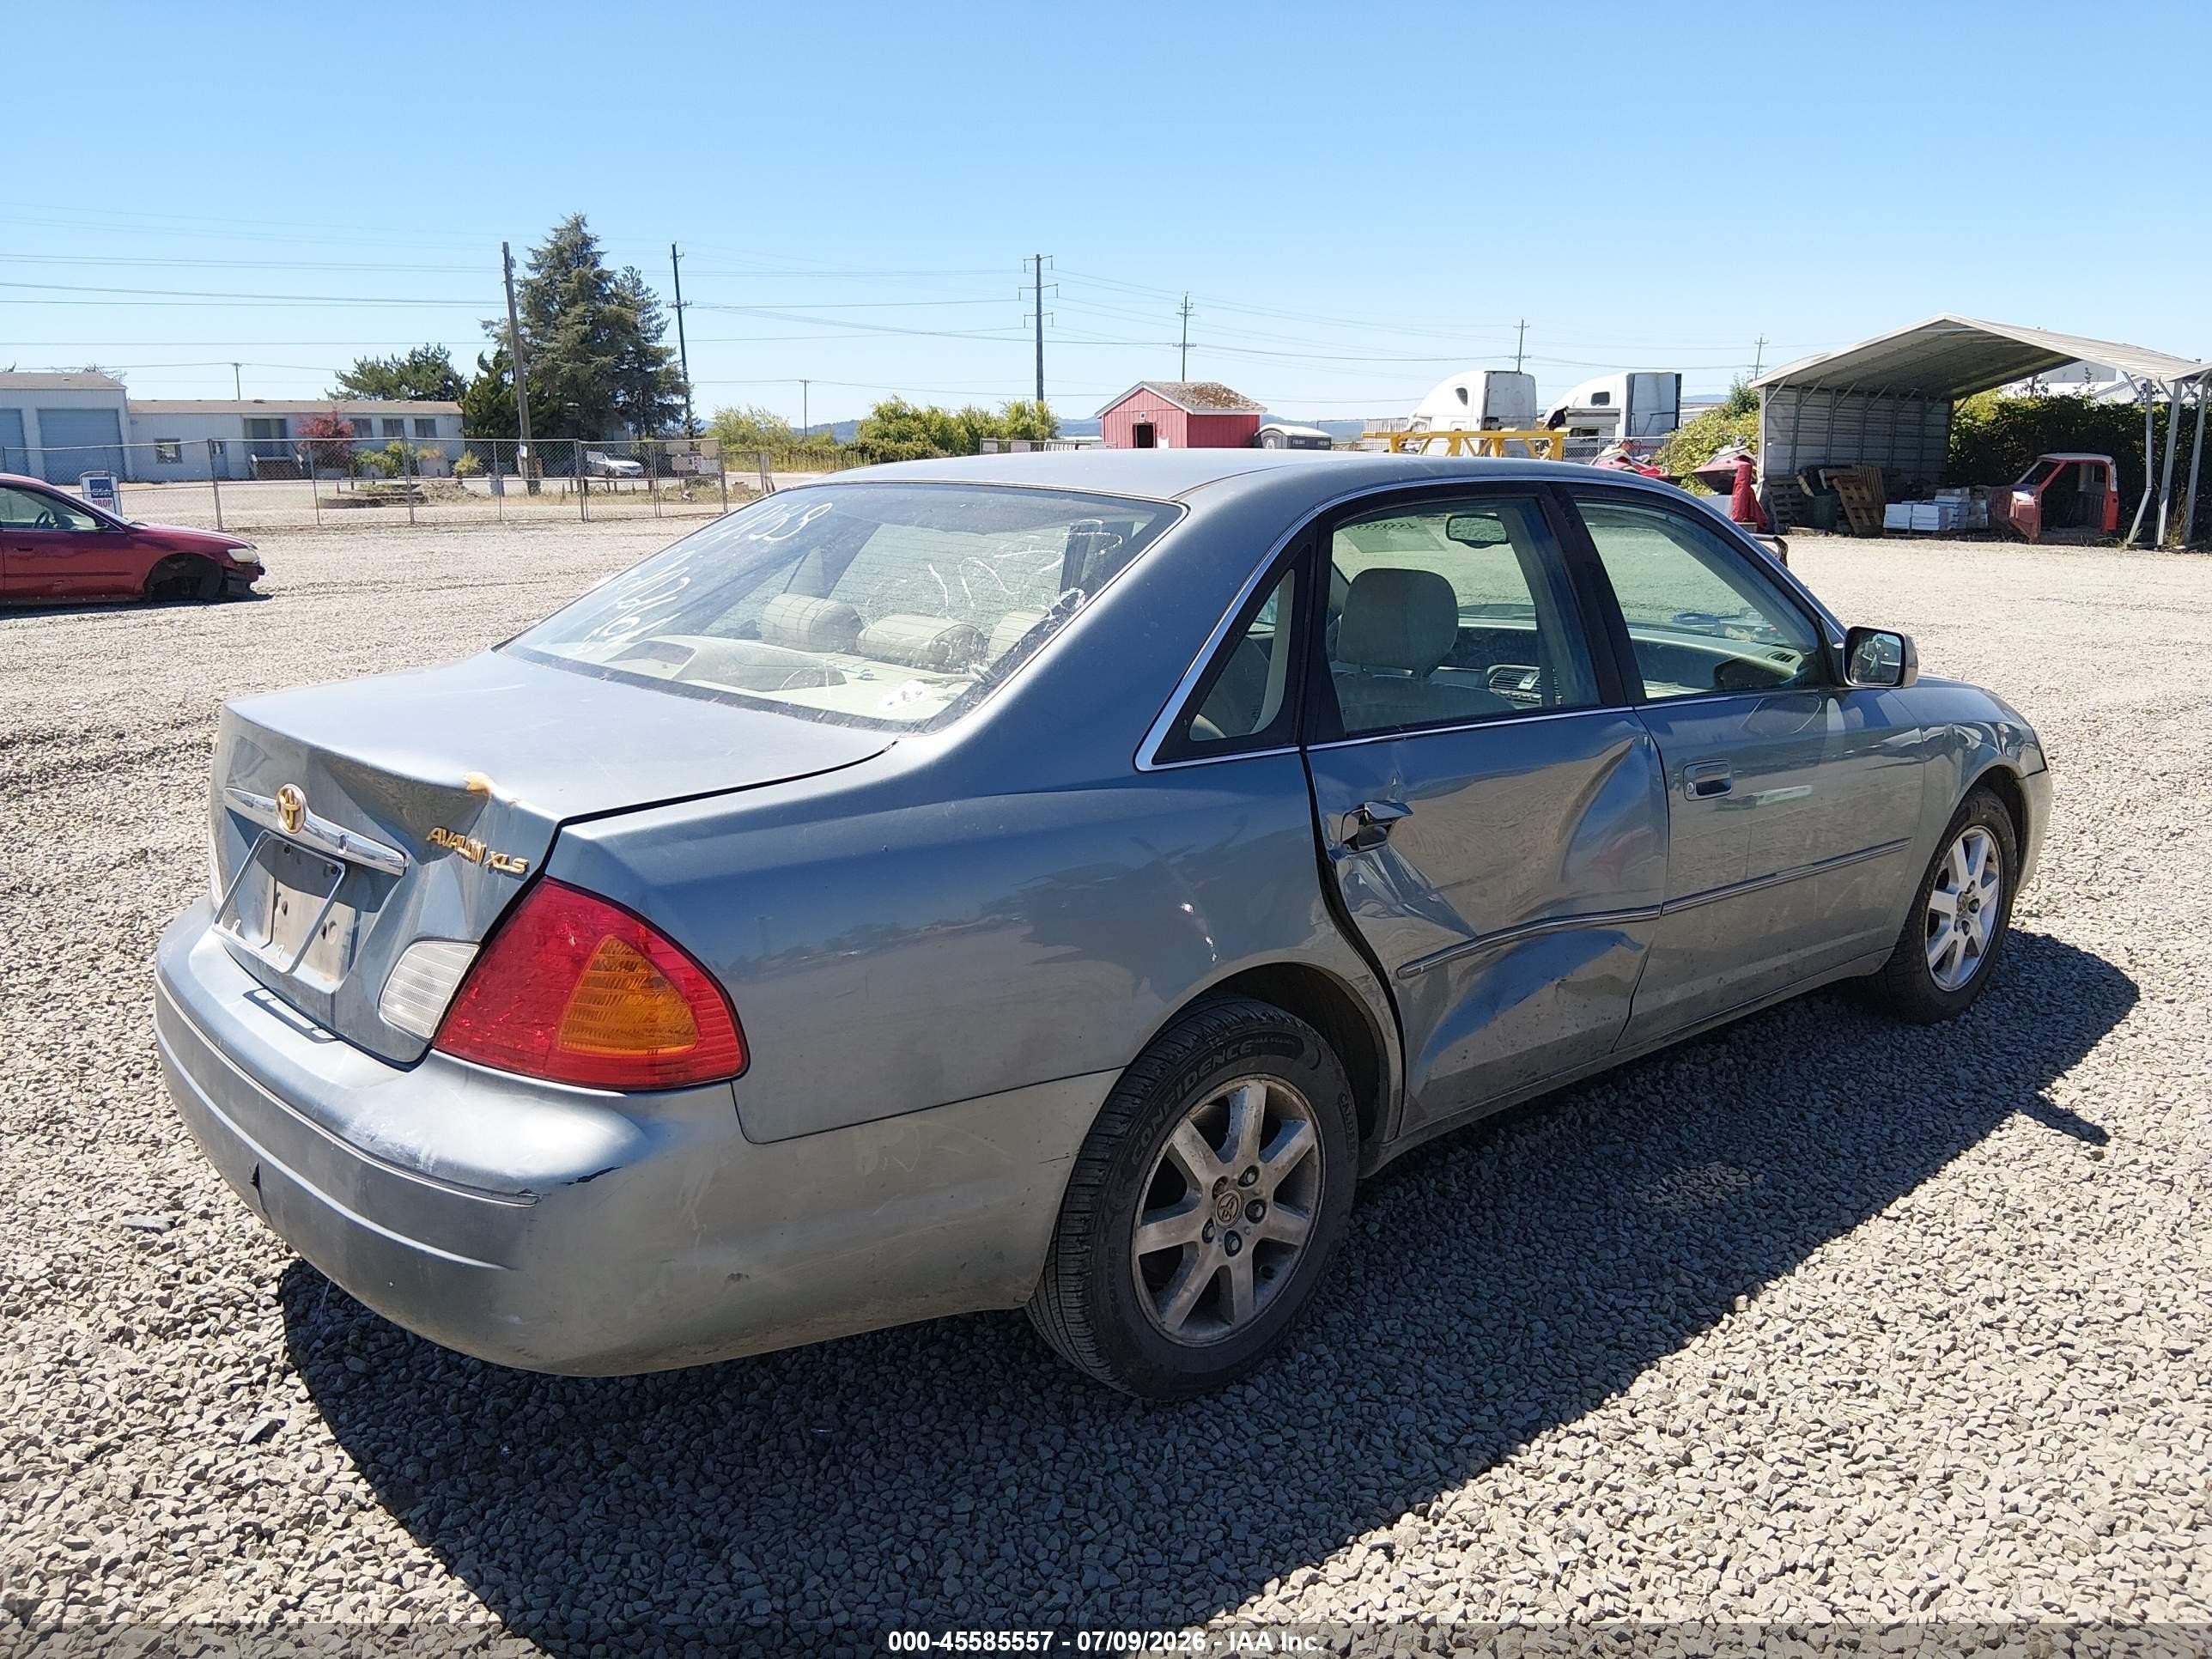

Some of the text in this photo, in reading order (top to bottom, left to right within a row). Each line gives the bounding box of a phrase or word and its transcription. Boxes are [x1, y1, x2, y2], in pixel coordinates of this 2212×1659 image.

[92, 499, 112, 507] DROP
[426, 827, 530, 874] AVALON XLS
[1131, 1038, 1254, 1166] CONFIDENCE
